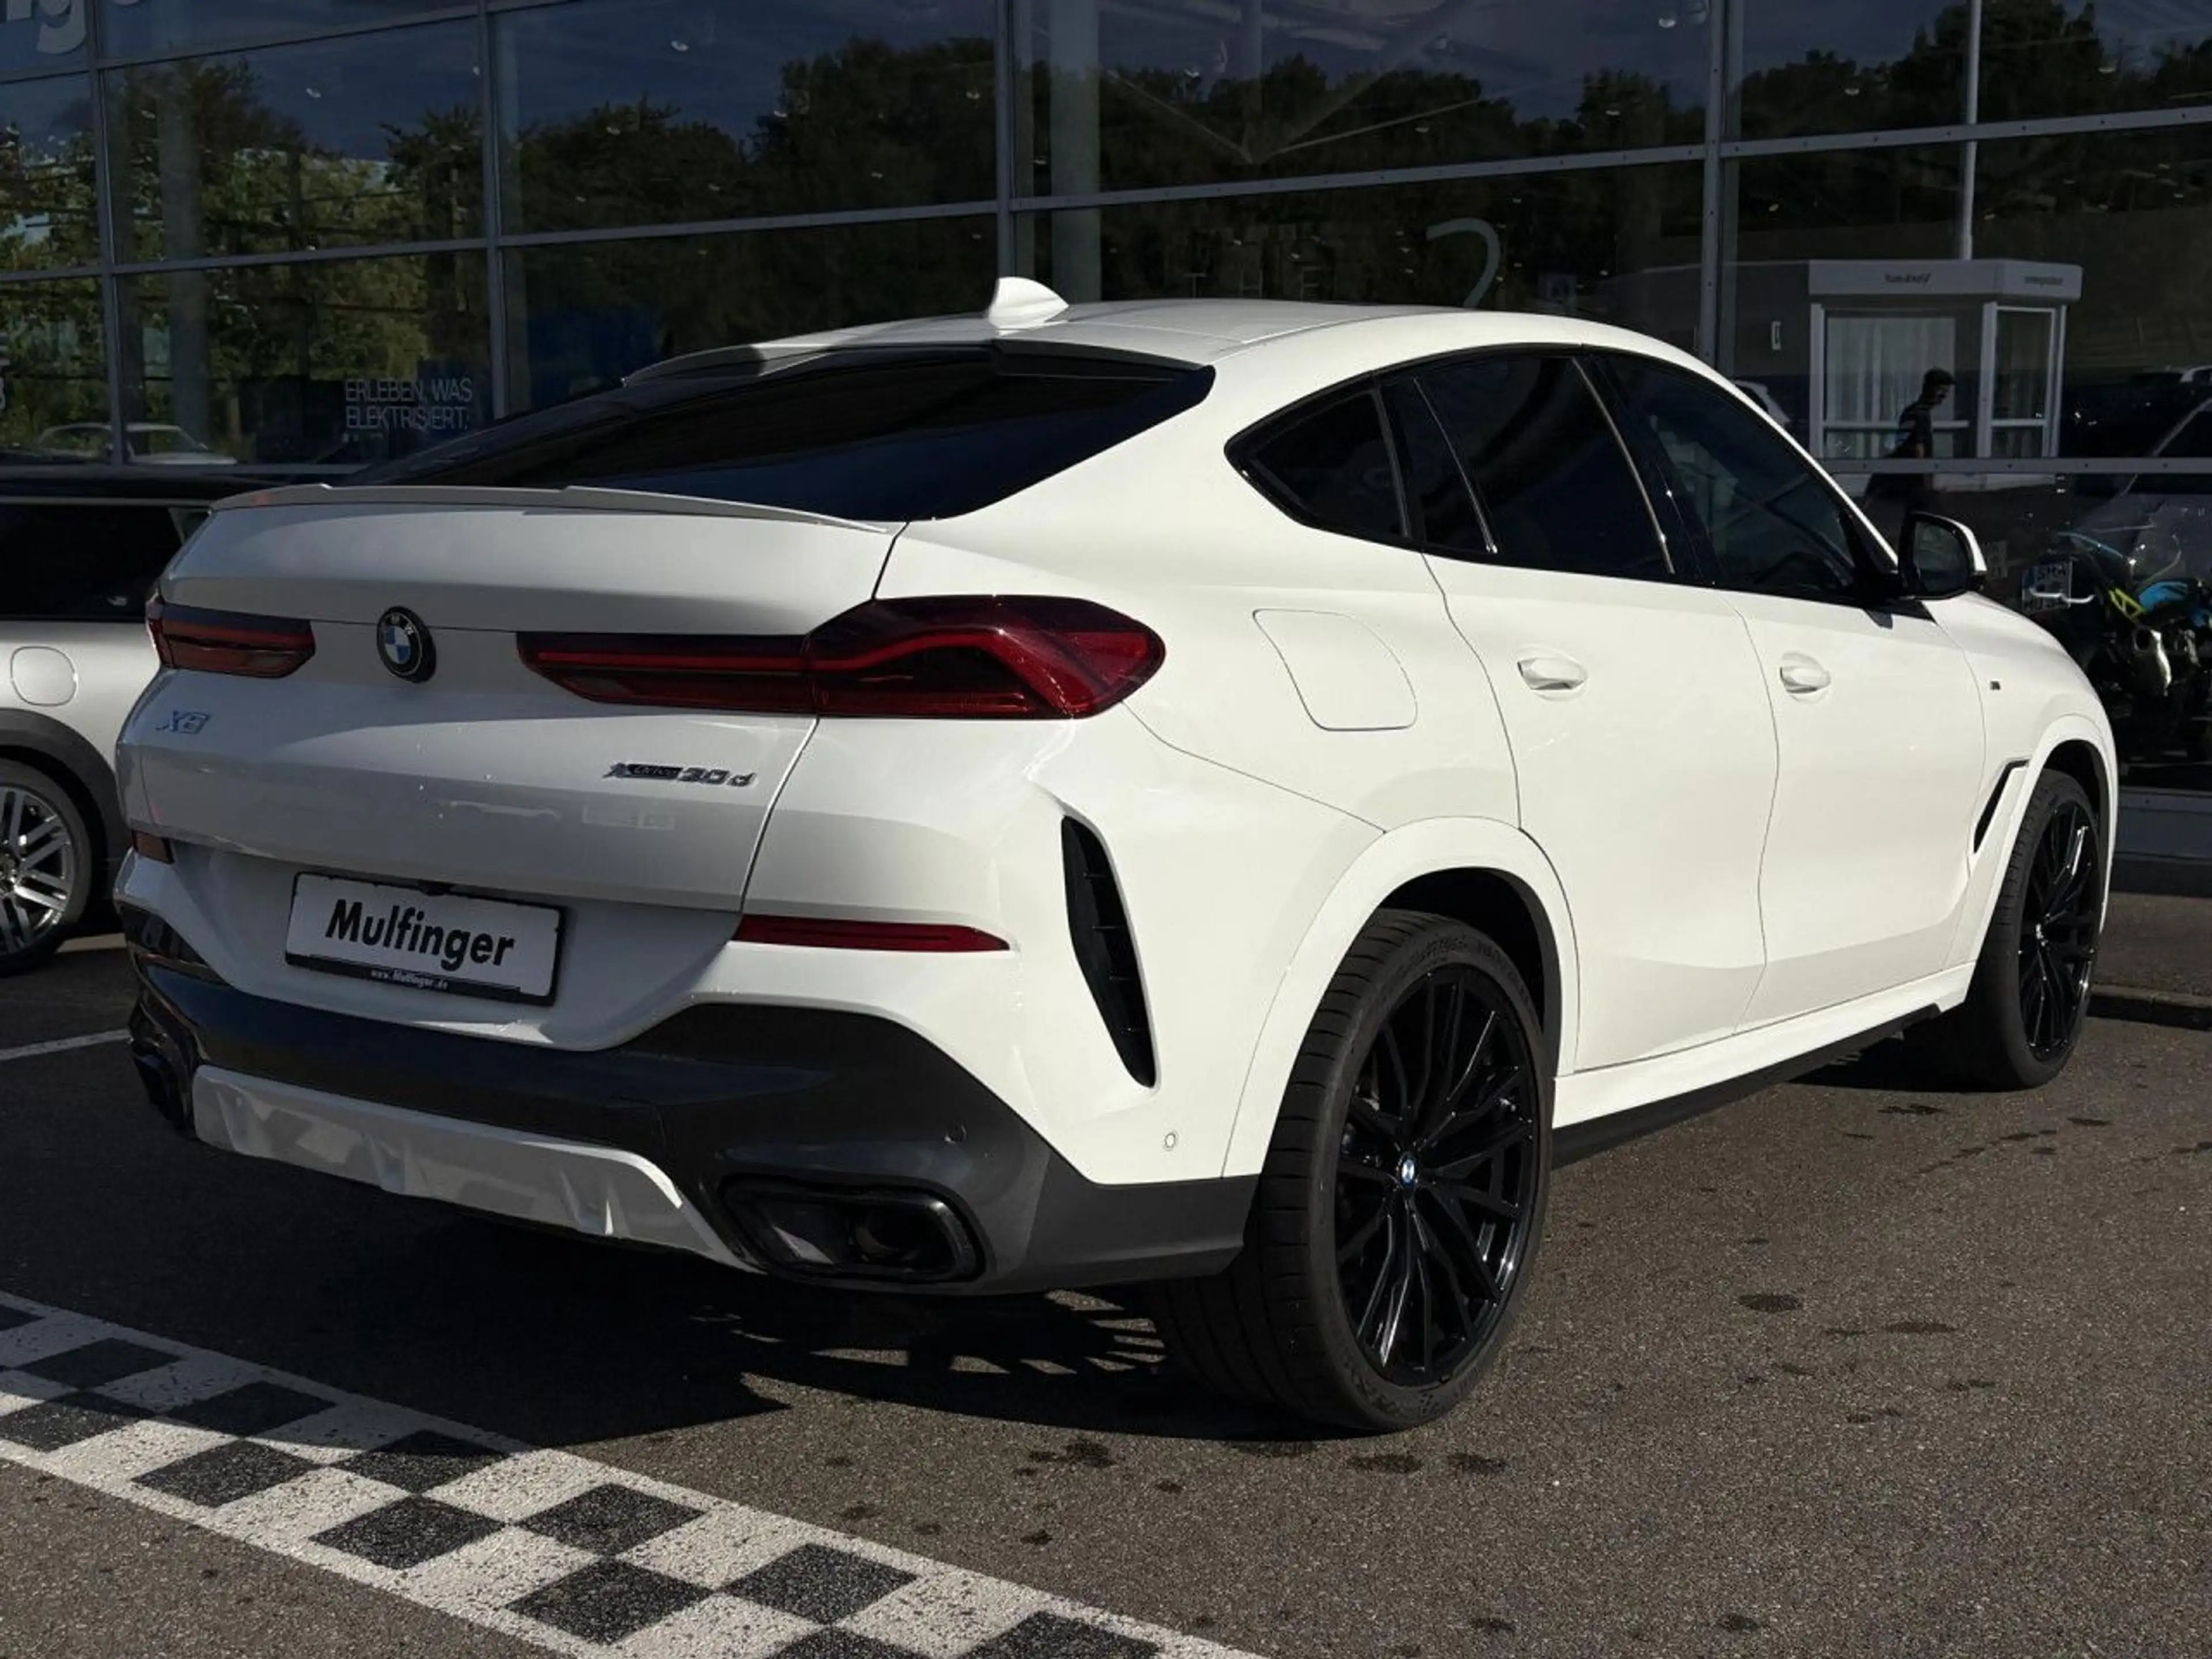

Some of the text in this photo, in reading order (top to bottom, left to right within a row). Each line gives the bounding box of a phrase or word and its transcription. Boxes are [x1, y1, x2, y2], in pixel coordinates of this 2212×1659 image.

[431, 377, 473, 403] WAS
[153, 709, 211, 734] X6
[324, 899, 516, 971] Mulfinger
